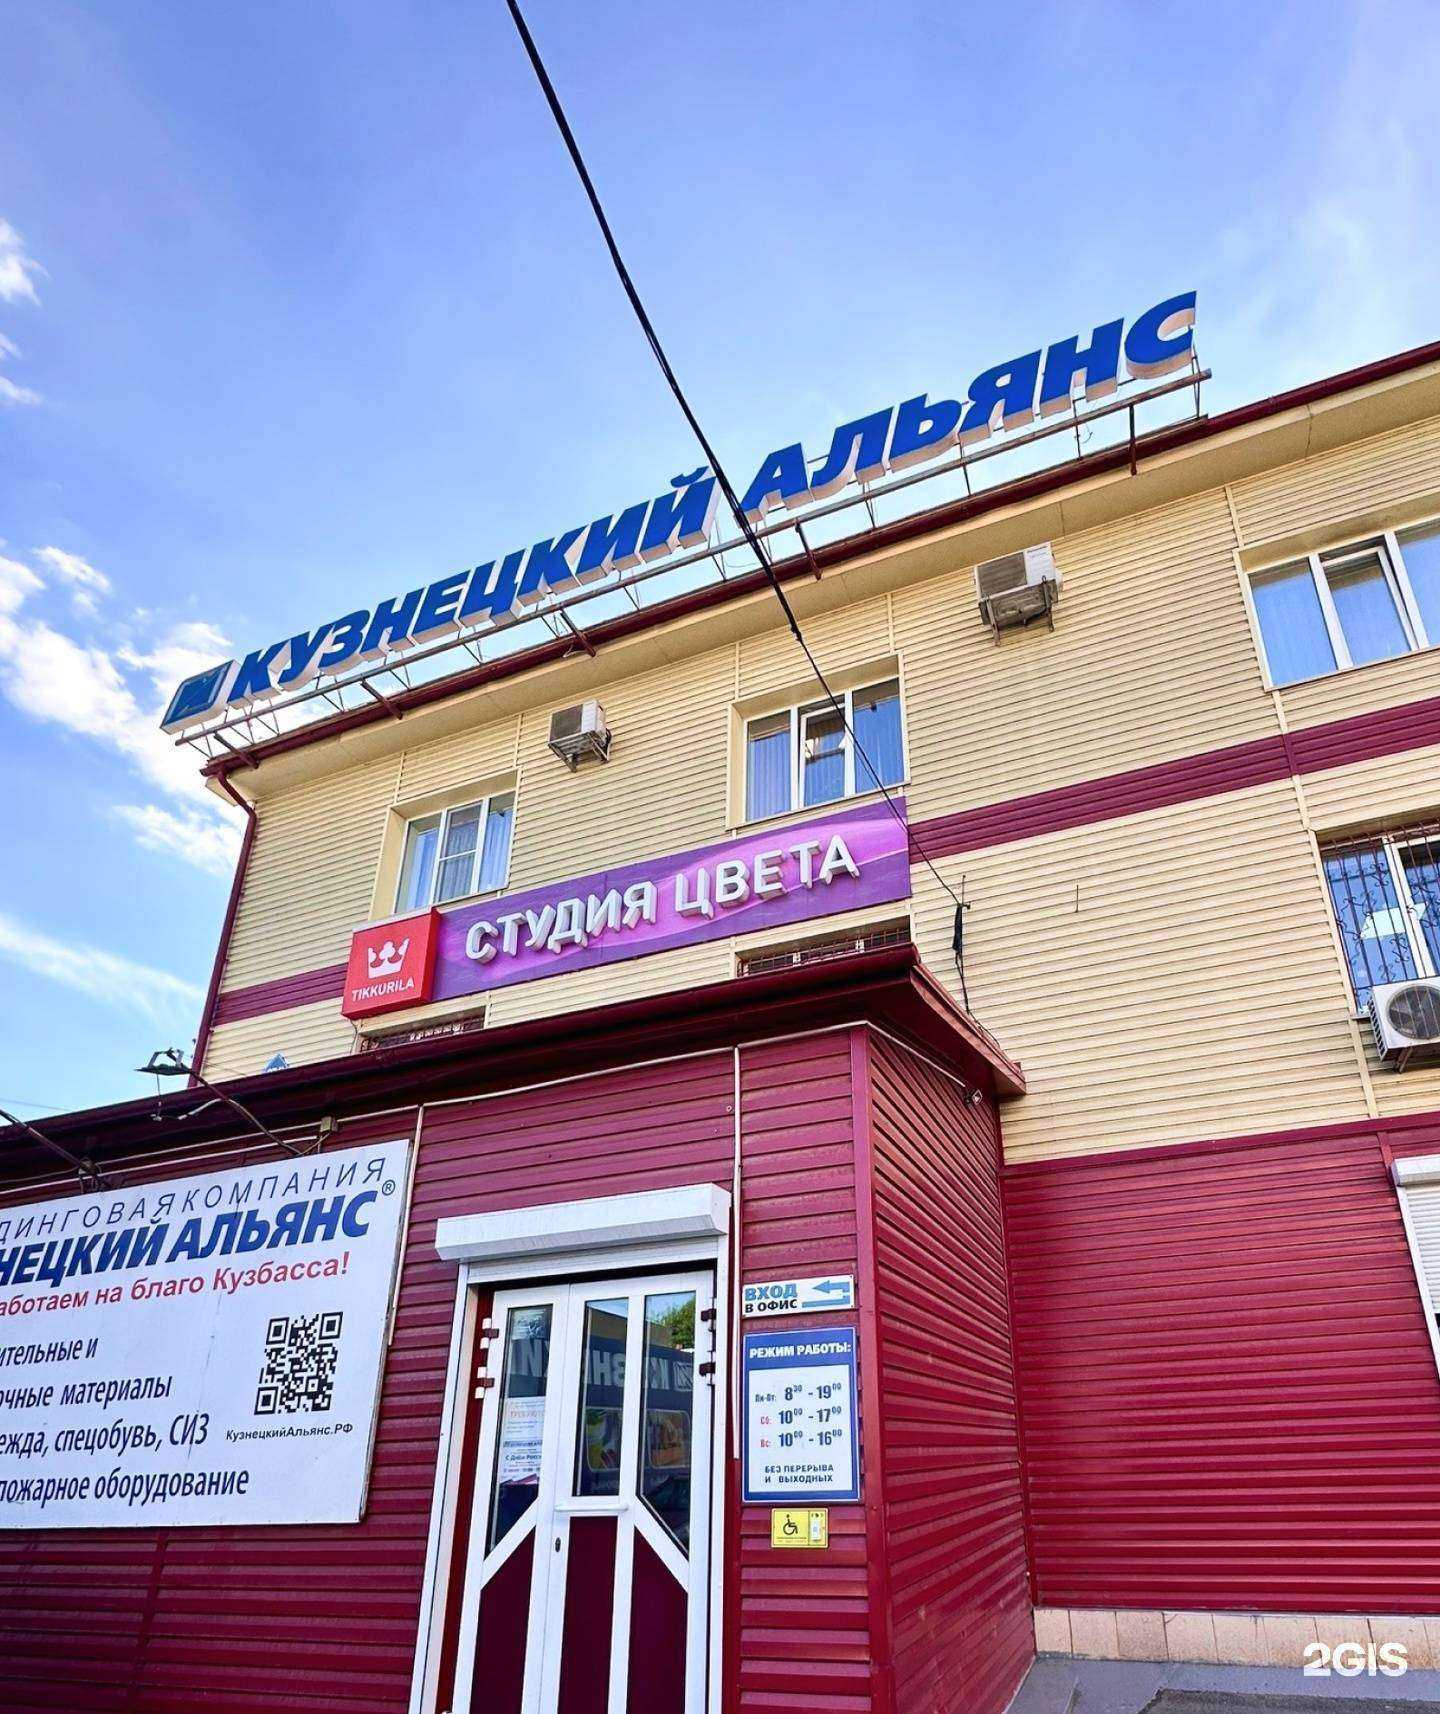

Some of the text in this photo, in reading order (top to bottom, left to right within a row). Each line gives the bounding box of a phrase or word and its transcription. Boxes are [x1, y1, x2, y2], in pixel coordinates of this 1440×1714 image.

[227, 290, 1198, 704] КУЗНЕЦКИЙ АЛЬЯНС
[465, 834, 860, 963] СТУДИЯ ЦВЕТА
[351, 977, 415, 1002] TIKKURILA
[95, 1285, 121, 1305] на
[130, 1274, 204, 1301] благо
[212, 1251, 350, 1294] Кузбасса!
[745, 1283, 798, 1301] ВХОД
[745, 1299, 798, 1314] В ОФИС
[85, 1337, 99, 1359] и
[749, 1342, 852, 1359] РЕЖИМ РАБОТЫ:
[60, 1376, 173, 1409] материалы
[54, 1418, 163, 1457] спецобувь,
[169, 1412, 210, 1446] СИЗ
[225, 1423, 353, 1442] КузнецкийАльянс.РФ
[765, 1464, 834, 1474] БЕЗ ПЕРЕРЫВА
[765, 1474, 834, 1484] И ВЫХОДНЫХ
[94, 1467, 249, 1507] оборудование
